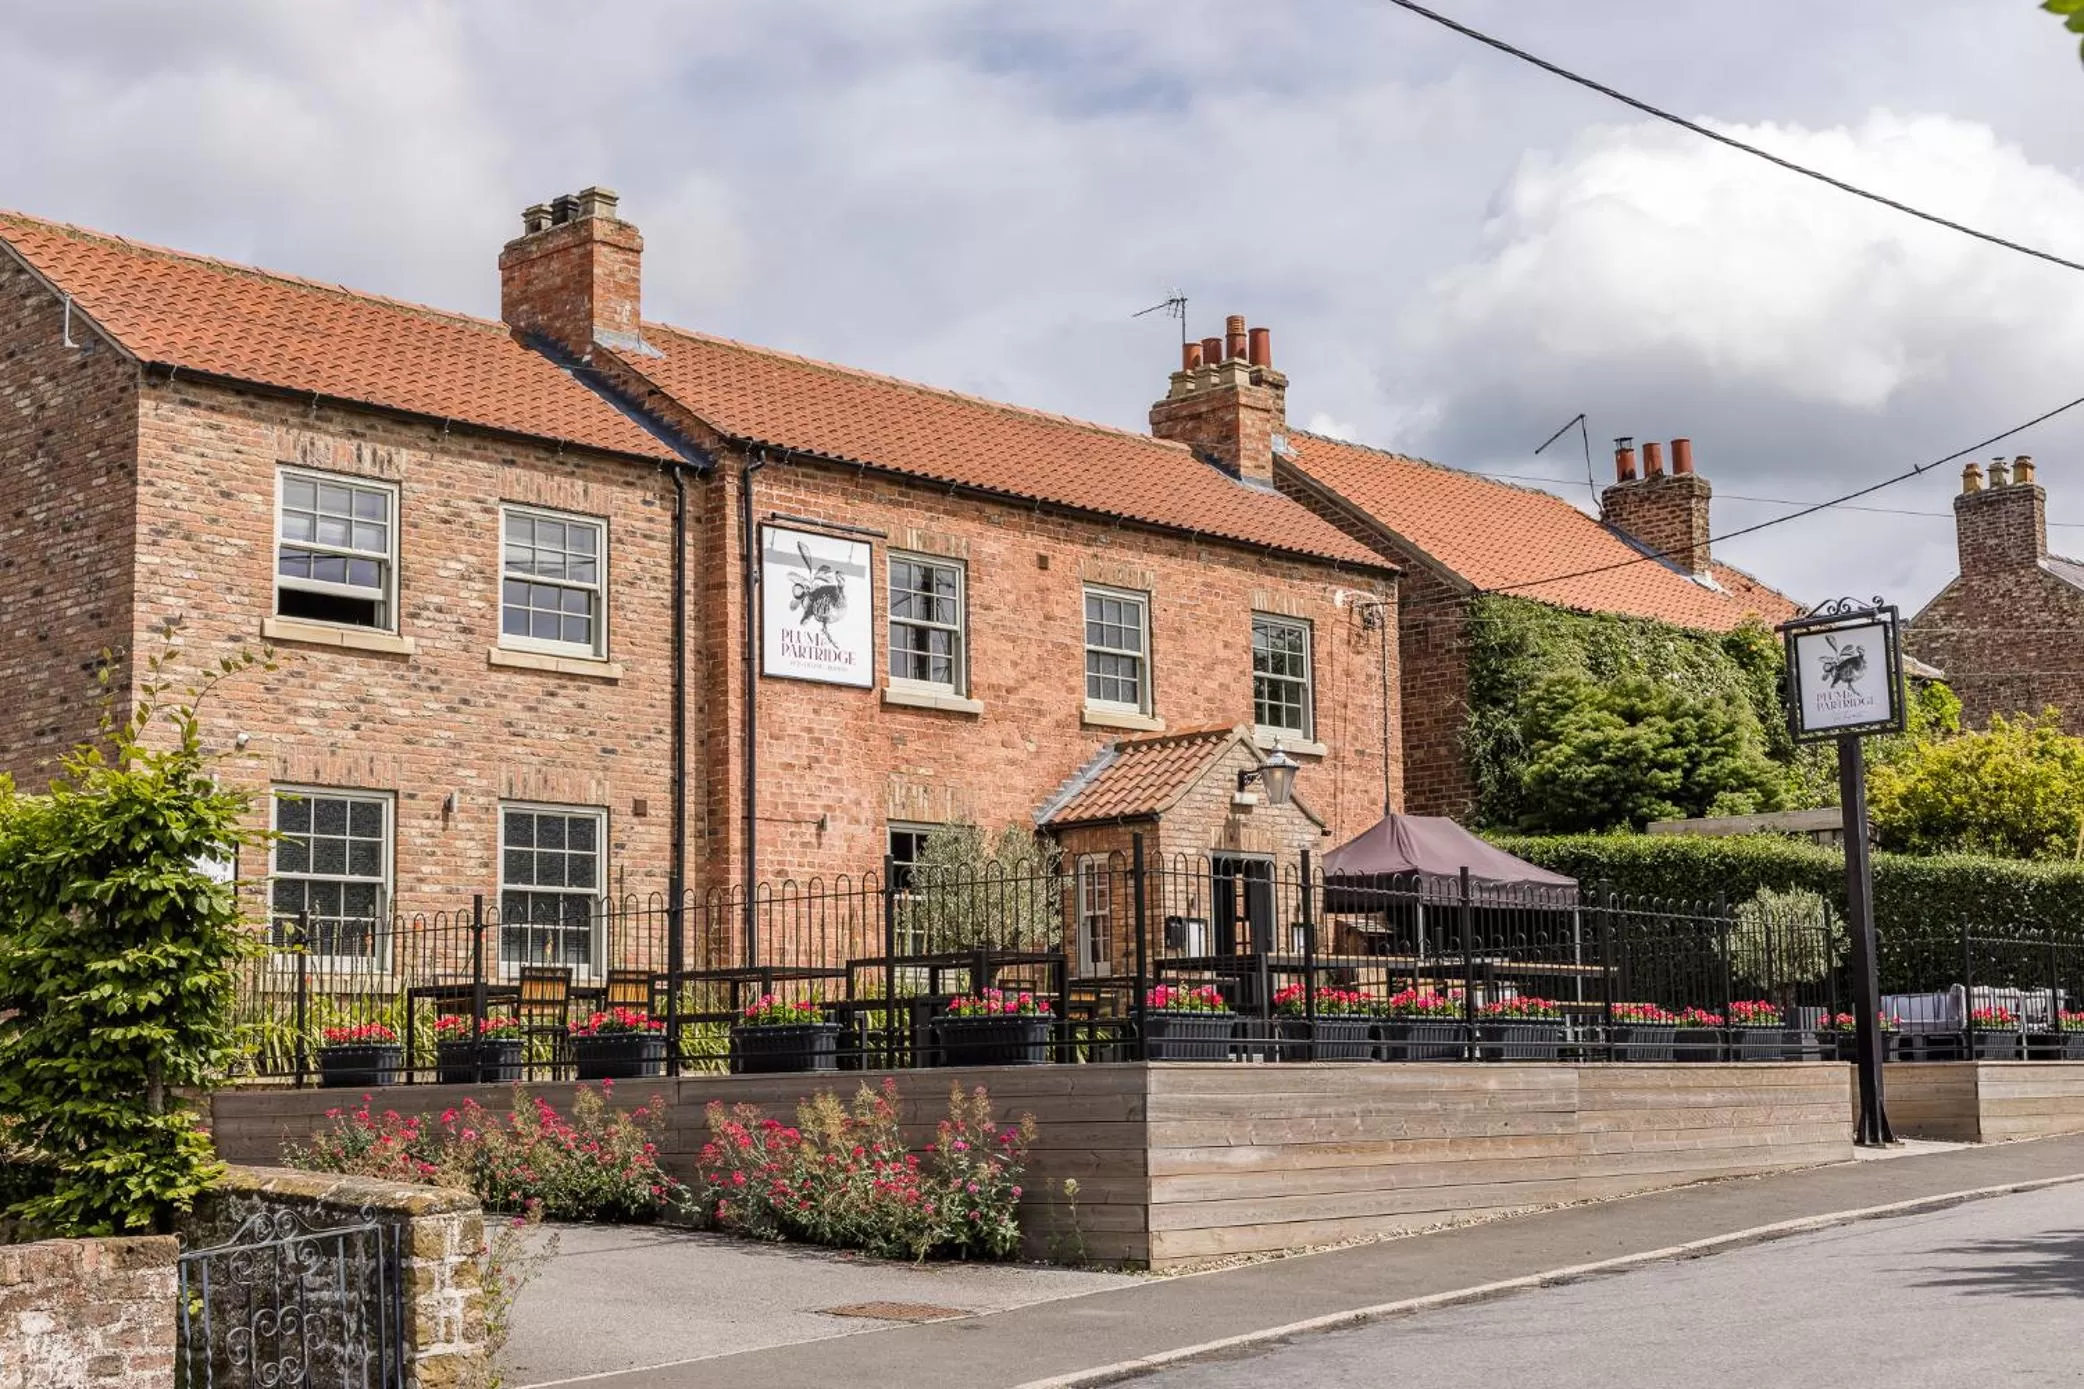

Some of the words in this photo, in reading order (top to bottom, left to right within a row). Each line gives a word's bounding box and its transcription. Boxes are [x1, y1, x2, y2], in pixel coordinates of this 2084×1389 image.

[781, 628, 819, 647] PLUM
[781, 642, 857, 666] PARTRIDGE
[1816, 696, 1874, 712] PARTRIDGE
